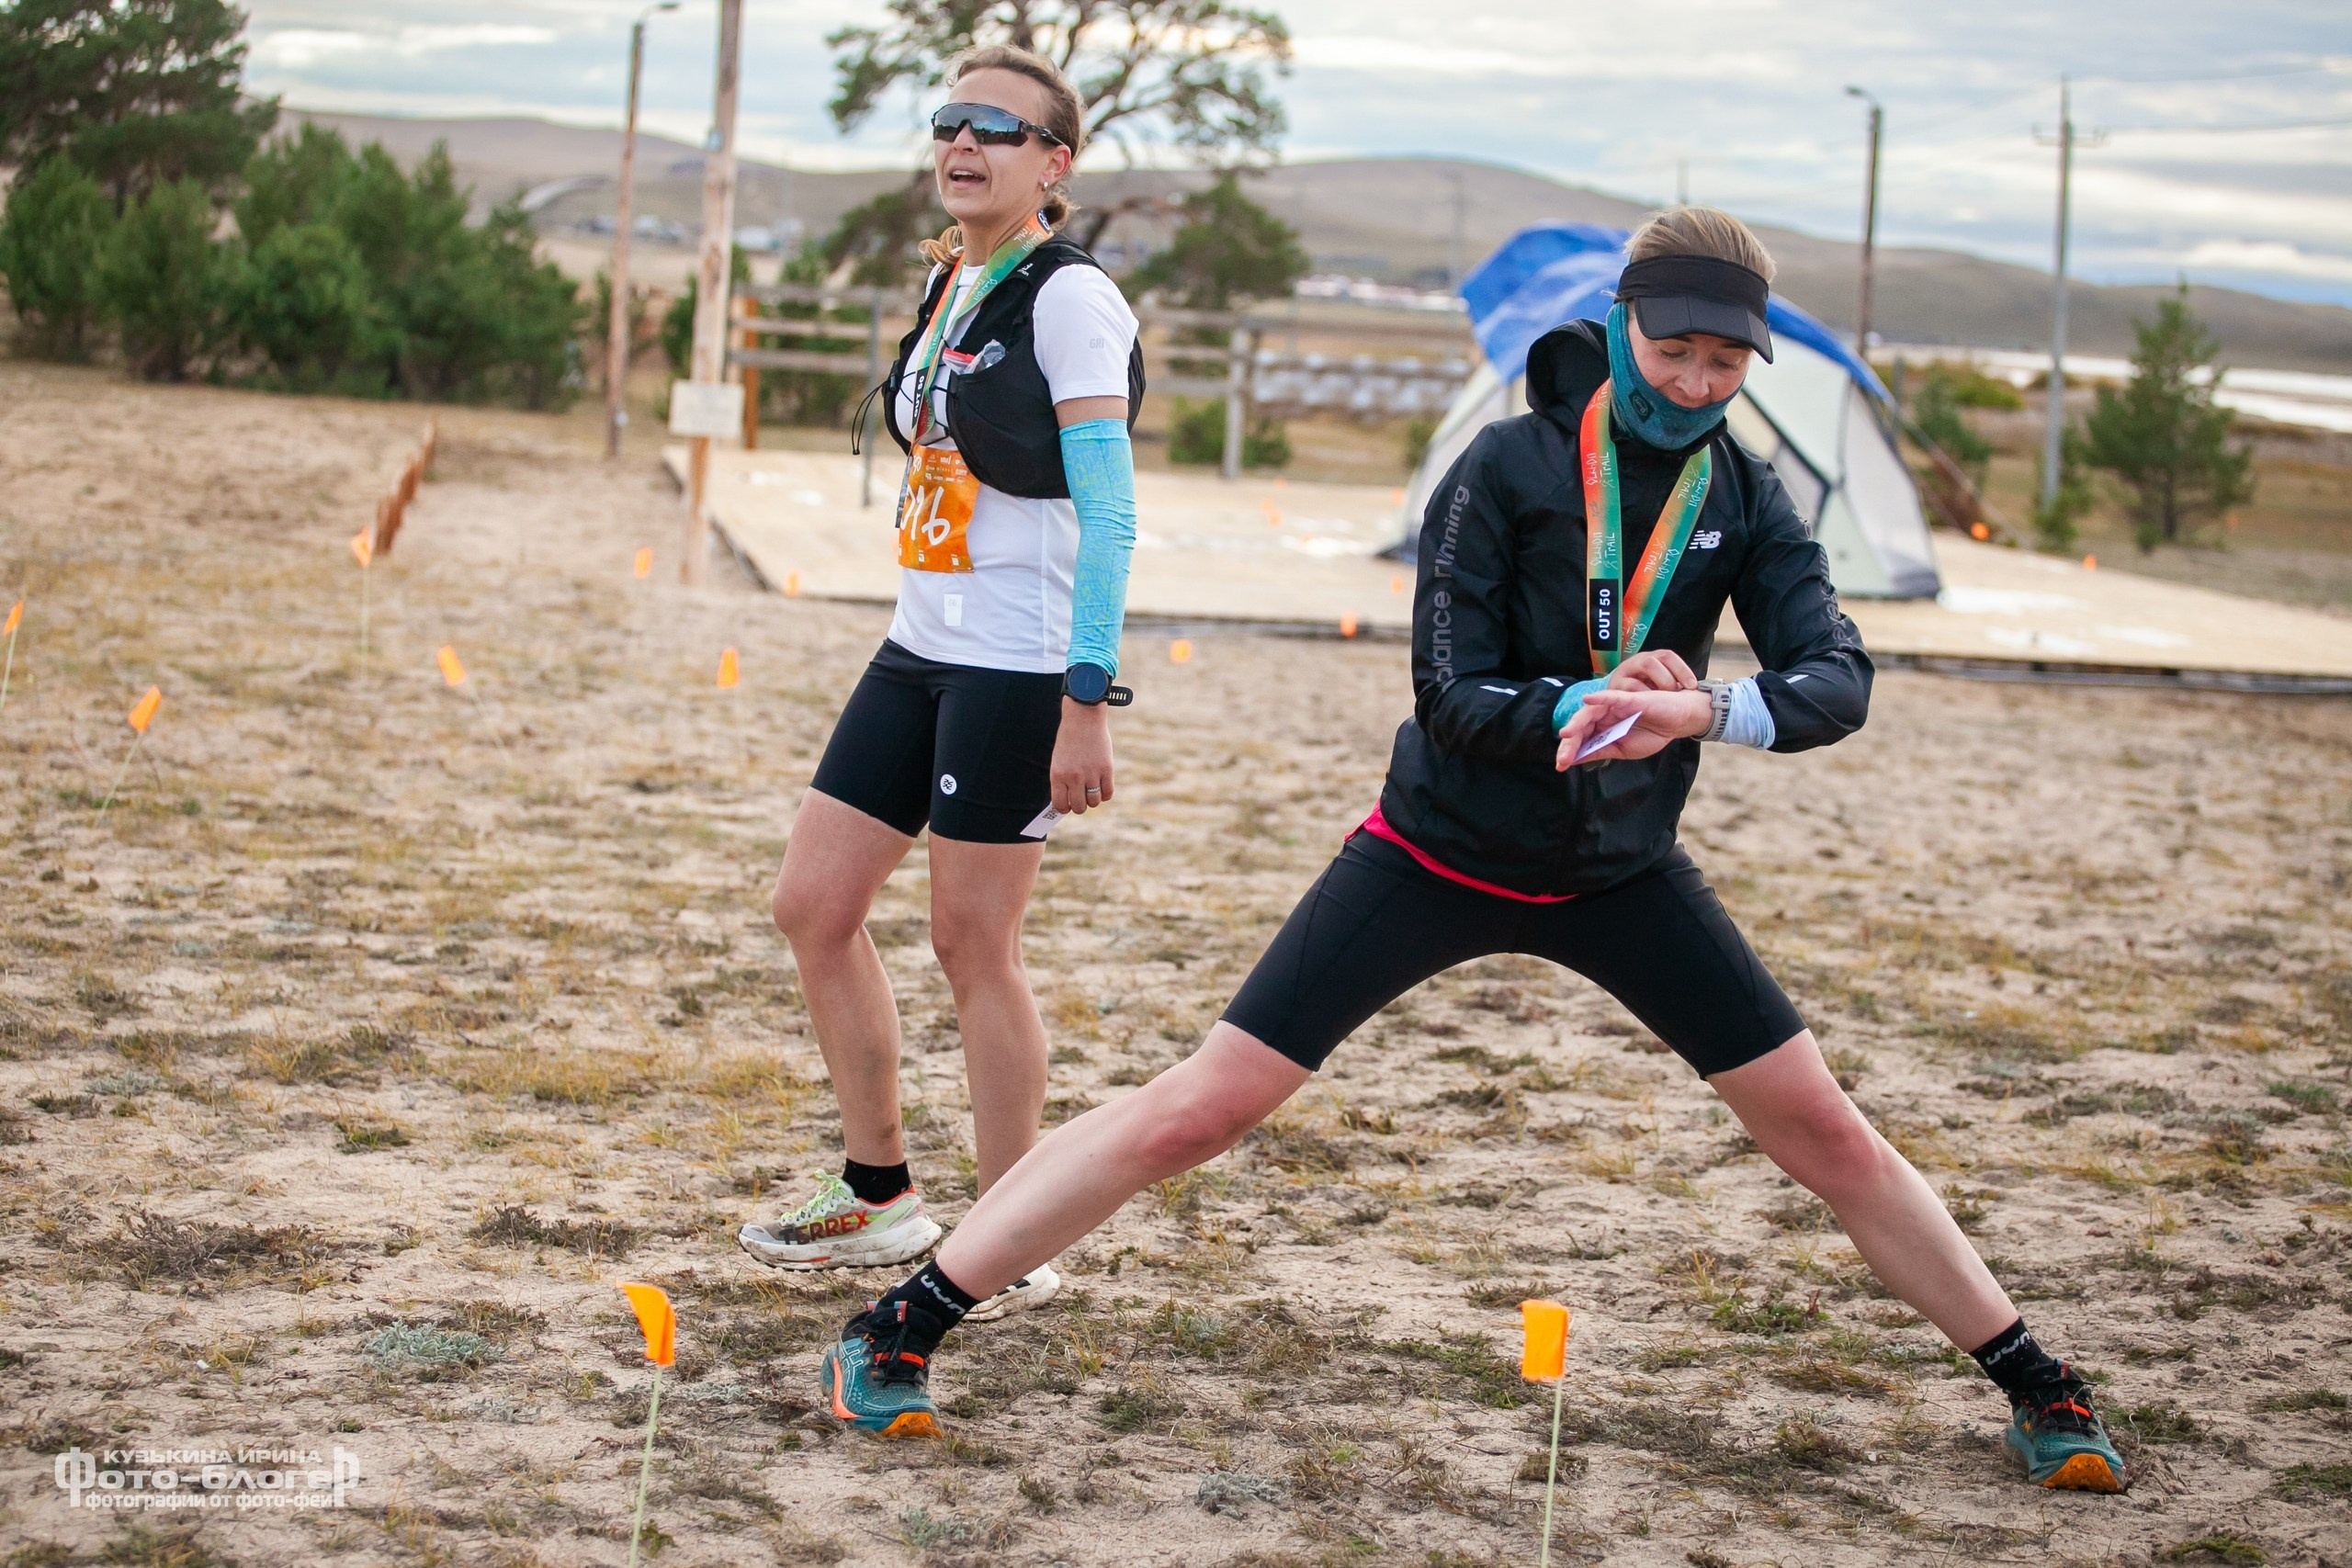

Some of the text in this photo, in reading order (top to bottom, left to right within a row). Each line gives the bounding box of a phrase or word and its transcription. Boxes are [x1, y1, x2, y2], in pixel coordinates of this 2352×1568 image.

[1599, 588, 1611, 640] OUT 50
[779, 1209, 870, 1246] TERREX
